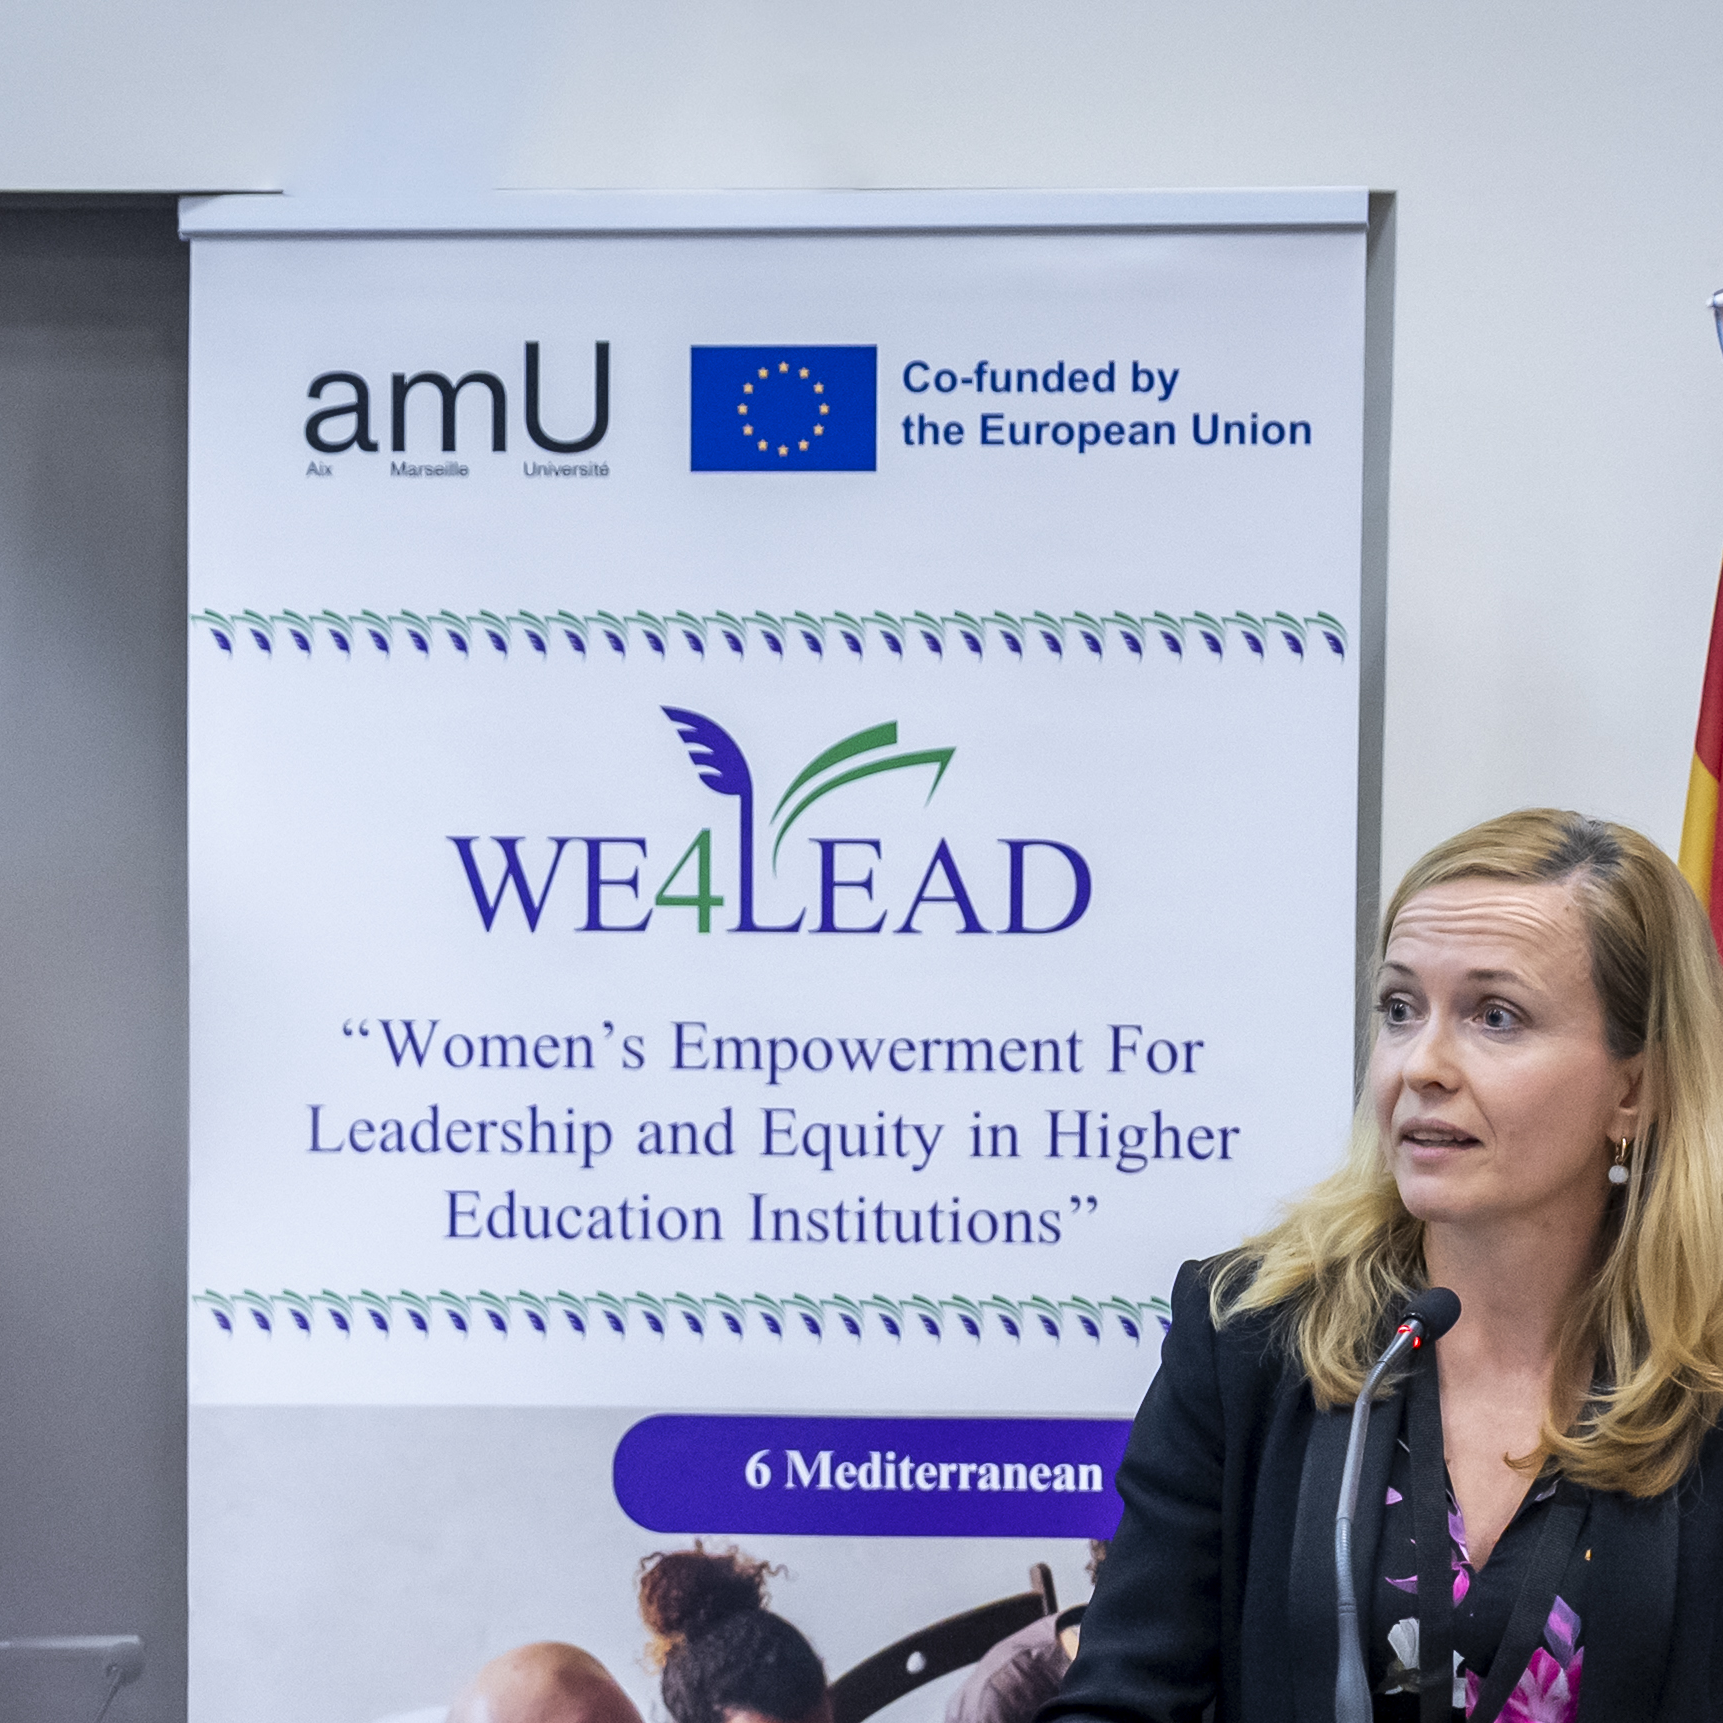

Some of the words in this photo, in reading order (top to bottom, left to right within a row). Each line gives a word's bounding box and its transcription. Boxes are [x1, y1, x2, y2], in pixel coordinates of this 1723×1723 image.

[303, 341, 610, 454] amU
[902, 360, 1117, 395] Co-funded
[1130, 361, 1179, 402] by
[901, 413, 967, 447] the
[980, 414, 1176, 455] European
[1191, 413, 1312, 447] Union
[305, 461, 333, 477] Aix
[390, 460, 470, 478] Marseille
[523, 459, 610, 477] Université
[446, 790, 1092, 935] WE4LEAD
[341, 1017, 645, 1073] “Women’s
[671, 1022, 1083, 1087] Empowerment
[1107, 1024, 1205, 1075] For
[305, 1104, 614, 1169] Leadership
[636, 1107, 736, 1157] and
[761, 1107, 944, 1172] Equity
[970, 1111, 1020, 1159] in
[1045, 1108, 1240, 1174] Higher
[444, 1190, 722, 1243] Education
[749, 1191, 1098, 1246] Institutions”
[745, 1449, 771, 1489] 6
[785, 1450, 1103, 1492] Mediterranean
